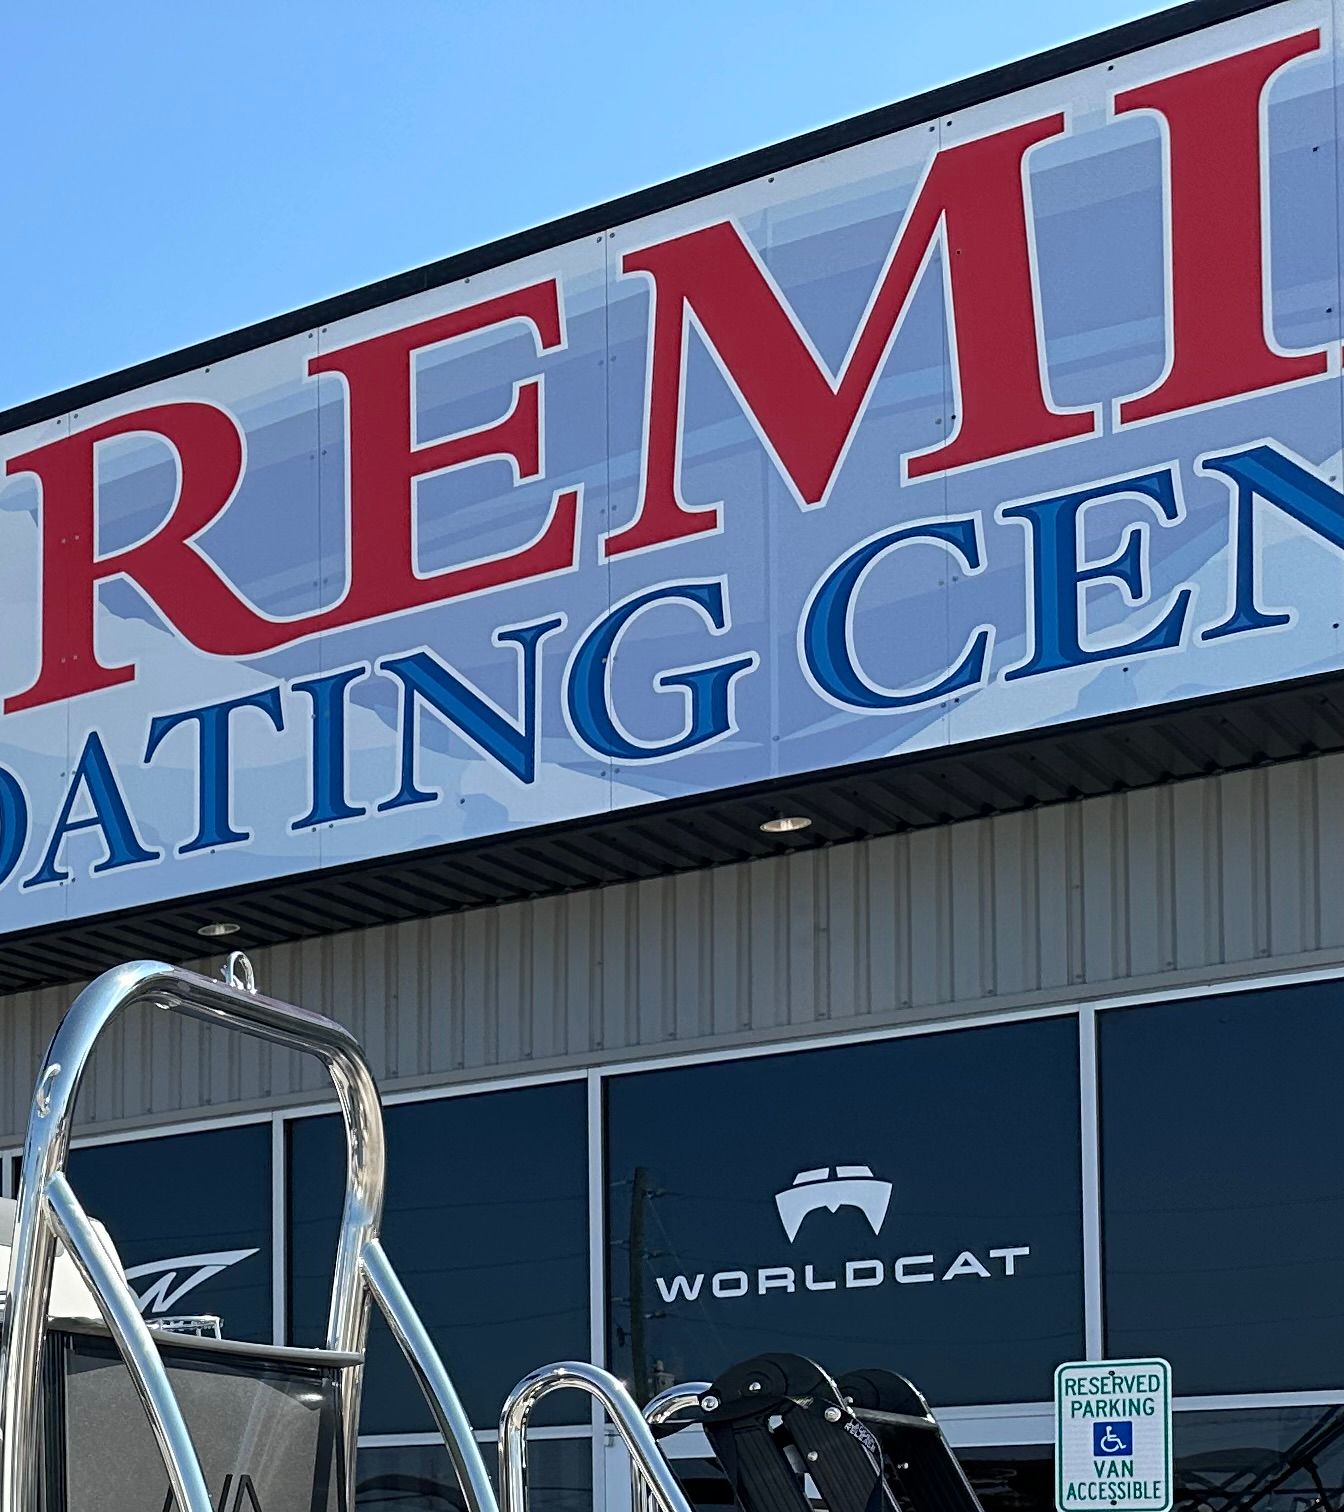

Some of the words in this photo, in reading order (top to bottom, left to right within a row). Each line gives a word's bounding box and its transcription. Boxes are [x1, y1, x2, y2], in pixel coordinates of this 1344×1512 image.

[803, 444, 1344, 709] CEN
[656, 1246, 1030, 1302] WORLDCAT
[1064, 1374, 1161, 1396] RESERVED
[1071, 1398, 1155, 1418] PARKING
[1093, 1460, 1134, 1478] VAN
[1066, 1481, 1162, 1500] ACCESSIBLE
